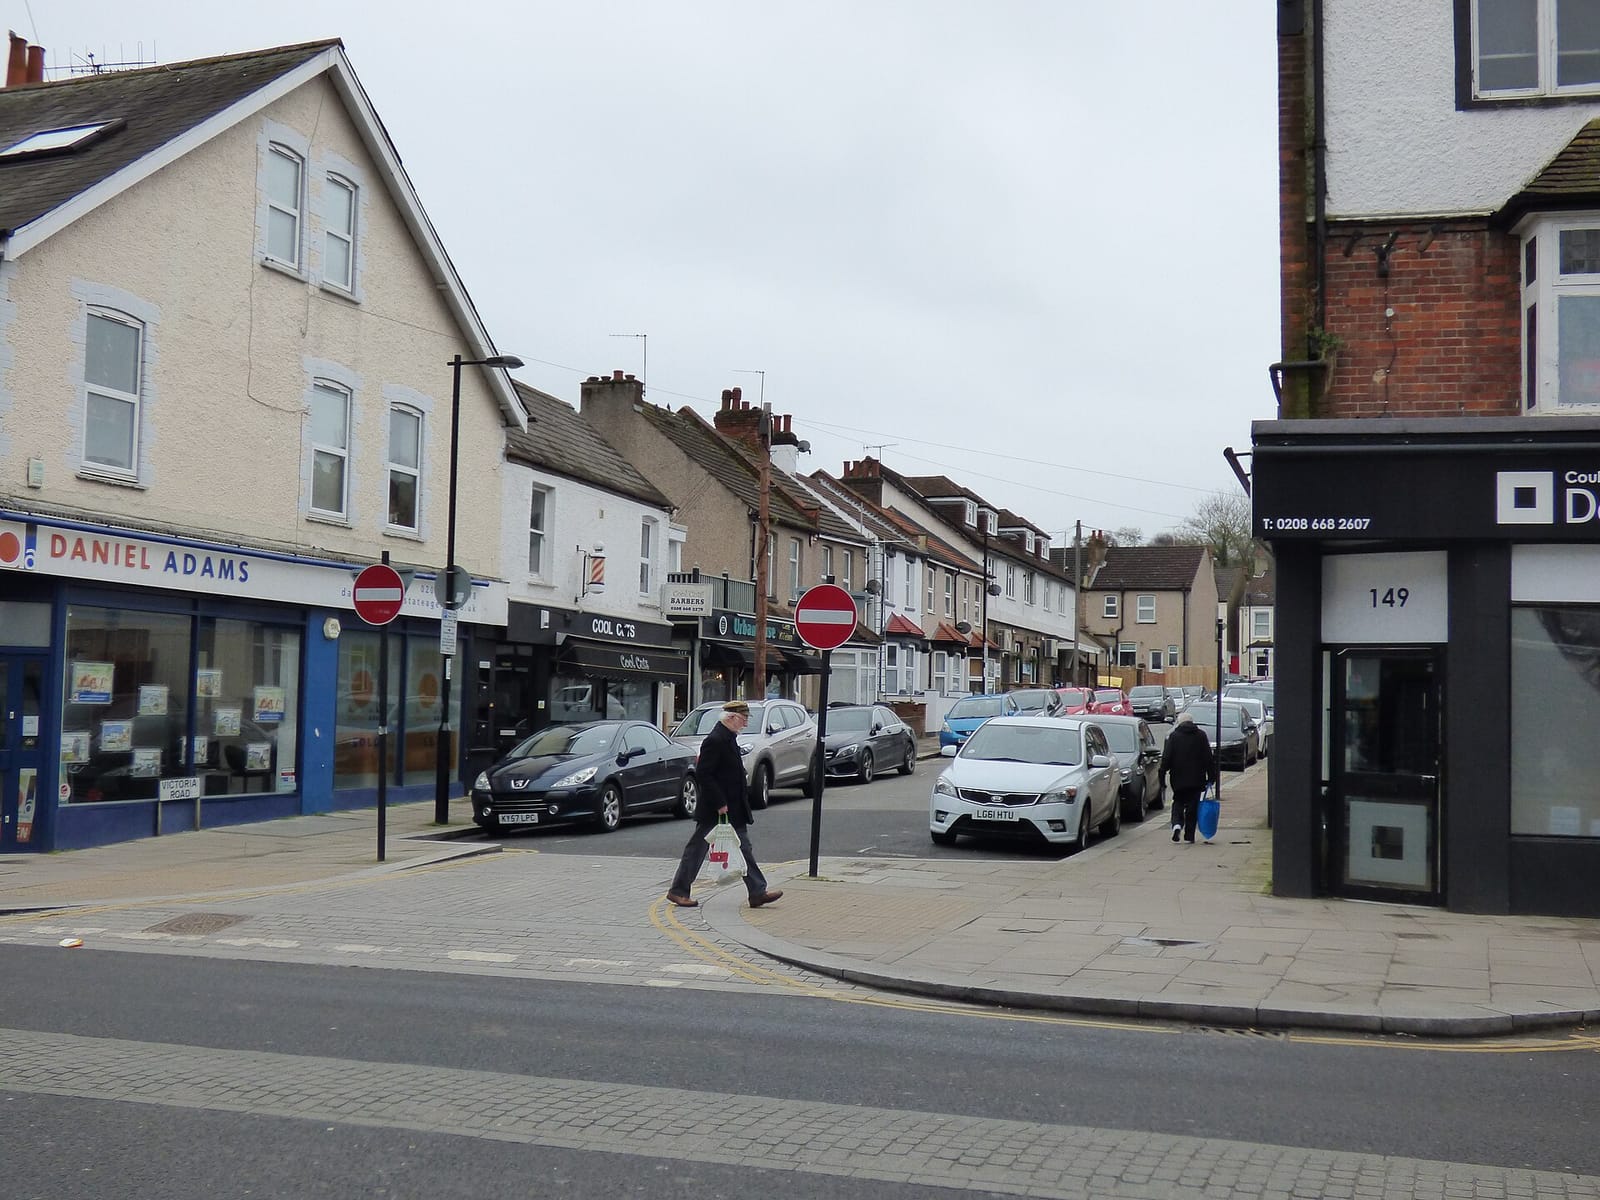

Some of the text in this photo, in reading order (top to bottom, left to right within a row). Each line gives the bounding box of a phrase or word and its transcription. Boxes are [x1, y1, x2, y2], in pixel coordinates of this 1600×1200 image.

[1263, 518, 1371, 530] T: 0208 668 2607
[51, 533, 249, 583] DANIEL ADAMS
[1370, 587, 1410, 608] 149
[592, 618, 614, 635] COOL
[620, 654, 650, 671] Cool Cats
[161, 779, 197, 790] VICTORIA
[170, 789, 191, 799] ROAD
[976, 810, 1015, 820] LG61 HTU
